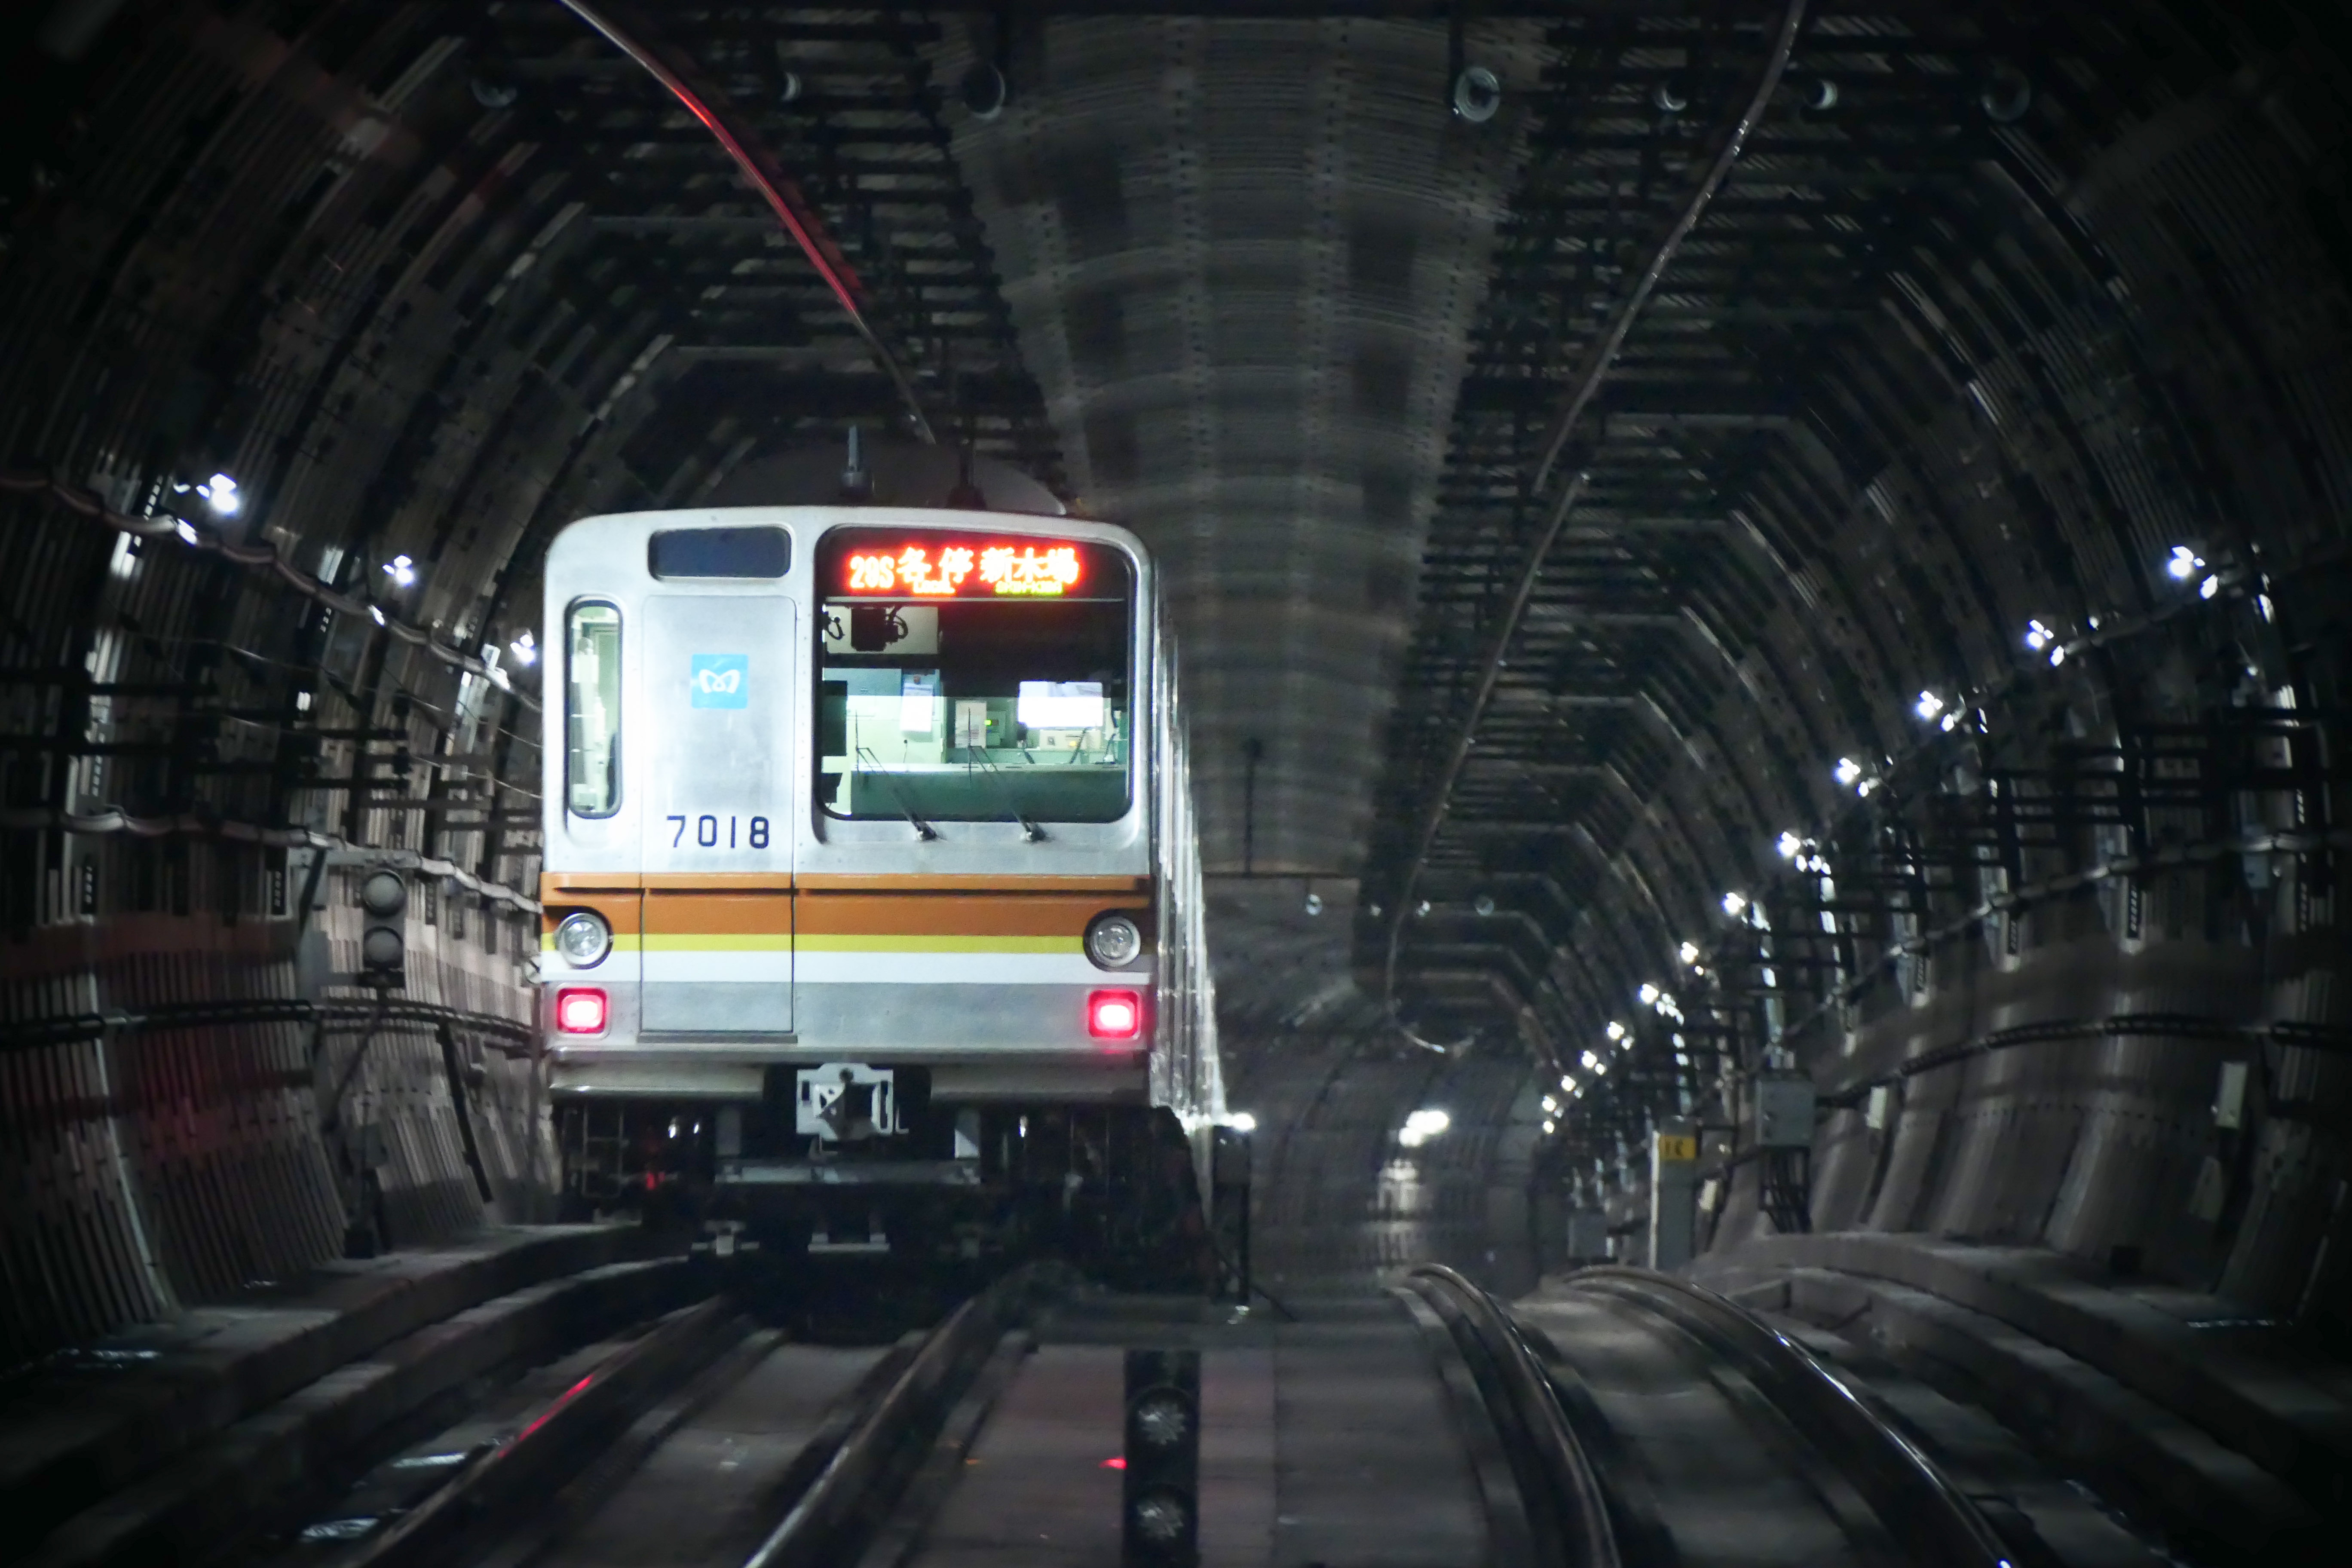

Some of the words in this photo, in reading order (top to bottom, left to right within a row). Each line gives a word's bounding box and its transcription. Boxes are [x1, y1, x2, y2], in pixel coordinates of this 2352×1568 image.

[896, 547, 974, 583] 各停
[980, 547, 1079, 584] 新木場
[666, 815, 769, 849] 7018
